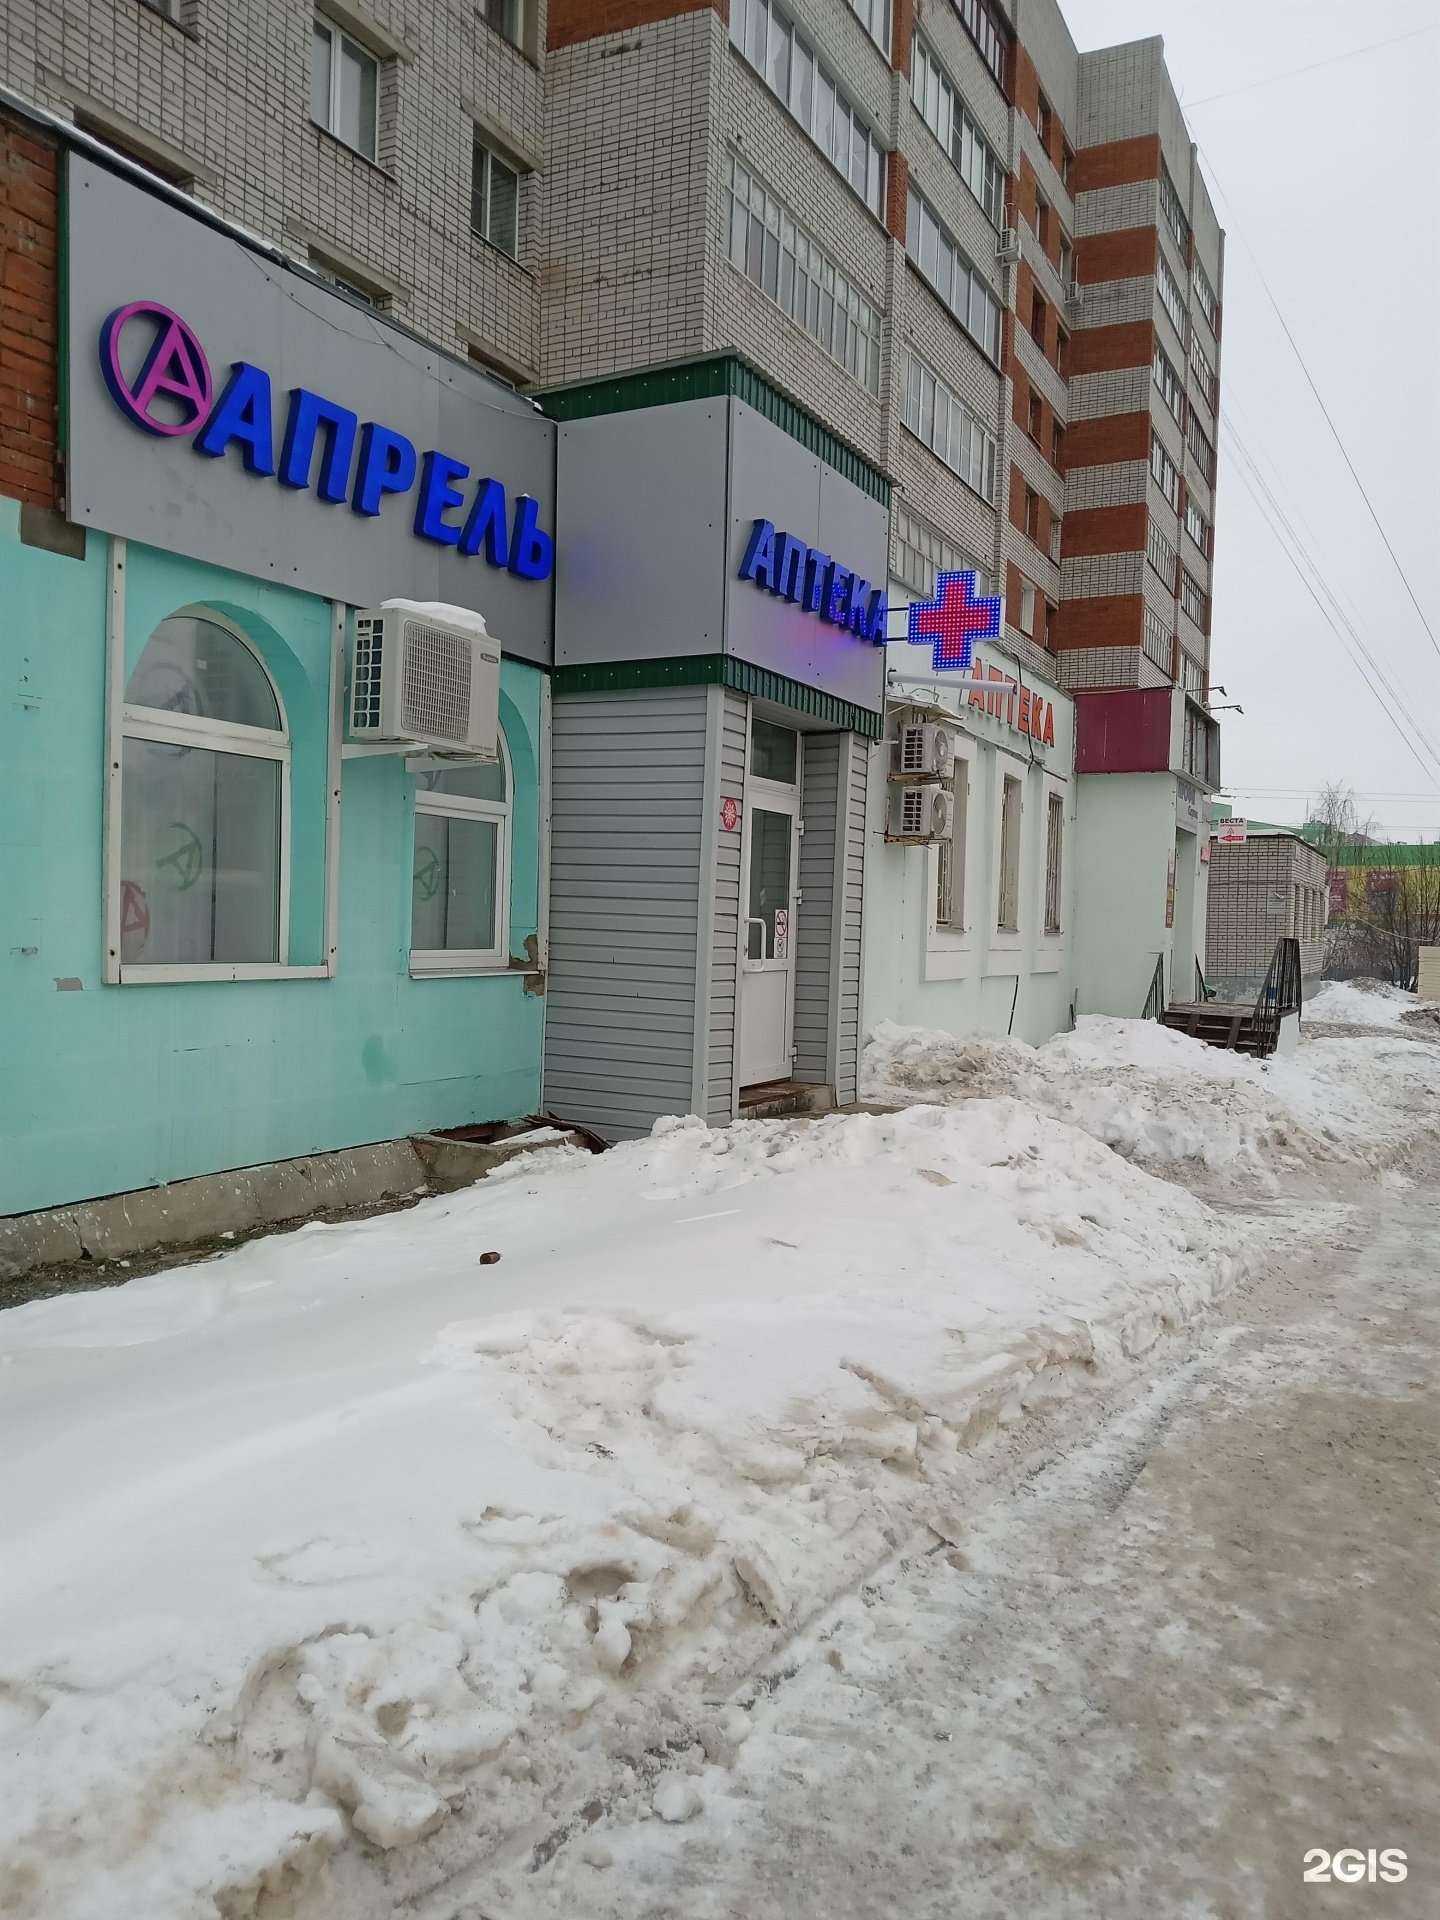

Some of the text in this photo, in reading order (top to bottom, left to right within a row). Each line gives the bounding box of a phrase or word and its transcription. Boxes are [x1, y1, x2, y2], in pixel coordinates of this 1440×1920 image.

[194, 361, 551, 580] АПРЕЛЬ
[738, 519, 887, 647] АПТЕКА
[968, 657, 1054, 748] АПТЕКА
